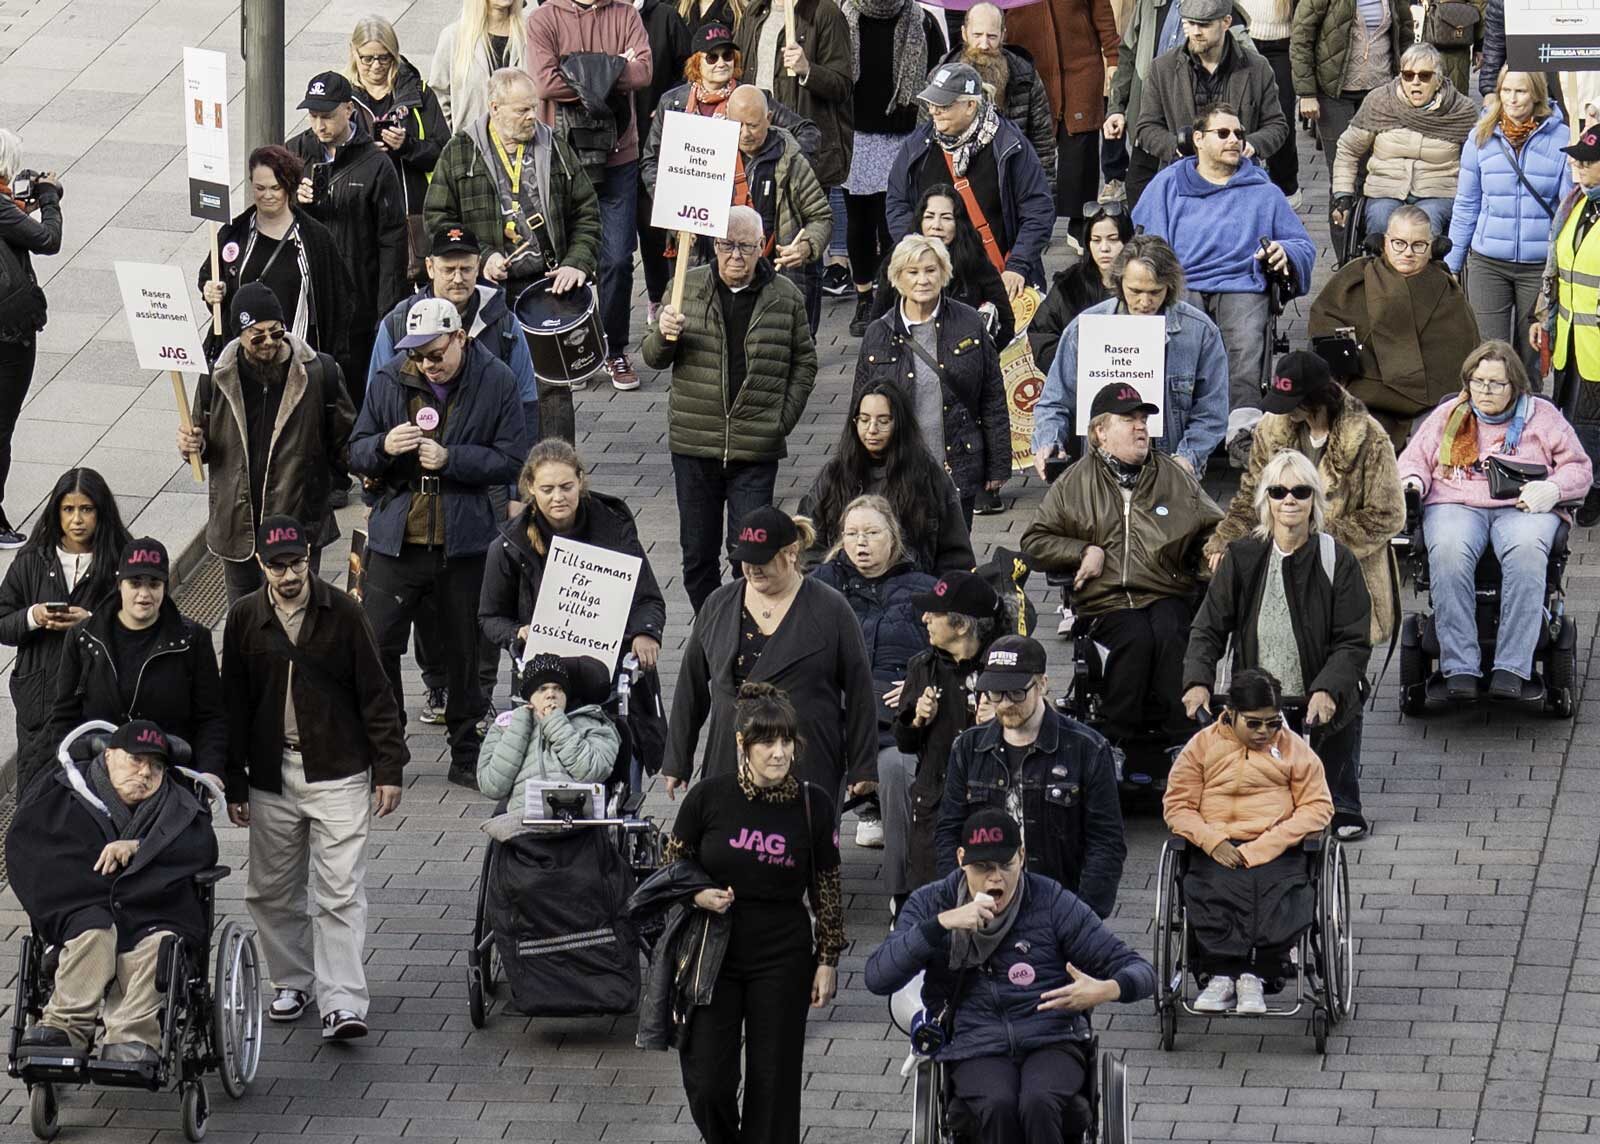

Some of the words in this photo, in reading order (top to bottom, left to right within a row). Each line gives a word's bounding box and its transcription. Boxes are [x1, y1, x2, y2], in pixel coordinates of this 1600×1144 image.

[705, 28, 730, 40] JAG
[684, 143, 716, 156] Rasera
[689, 155, 708, 167] inte
[668, 165, 726, 181] assistansen!
[677, 205, 709, 221] JAG
[141, 288, 171, 299] Rasera
[150, 300, 168, 310] inte
[135, 310, 189, 322] assistansen!
[159, 346, 187, 359] JAG
[1104, 344, 1140, 354] Rasera
[1111, 356, 1132, 366] inte
[1088, 368, 1154, 379] assistansen!
[1117, 388, 1140, 400] JA
[266, 527, 298, 545] JAG
[739, 527, 768, 543] JAG
[128, 549, 161, 564] JAG
[553, 546, 633, 582] Tillsammans
[571, 572, 592, 587] för
[558, 586, 601, 607] rimliga
[558, 600, 600, 619] villkor
[532, 623, 618, 654] assistansen!
[729, 827, 786, 855] JAG
[969, 826, 1004, 845] JAG
